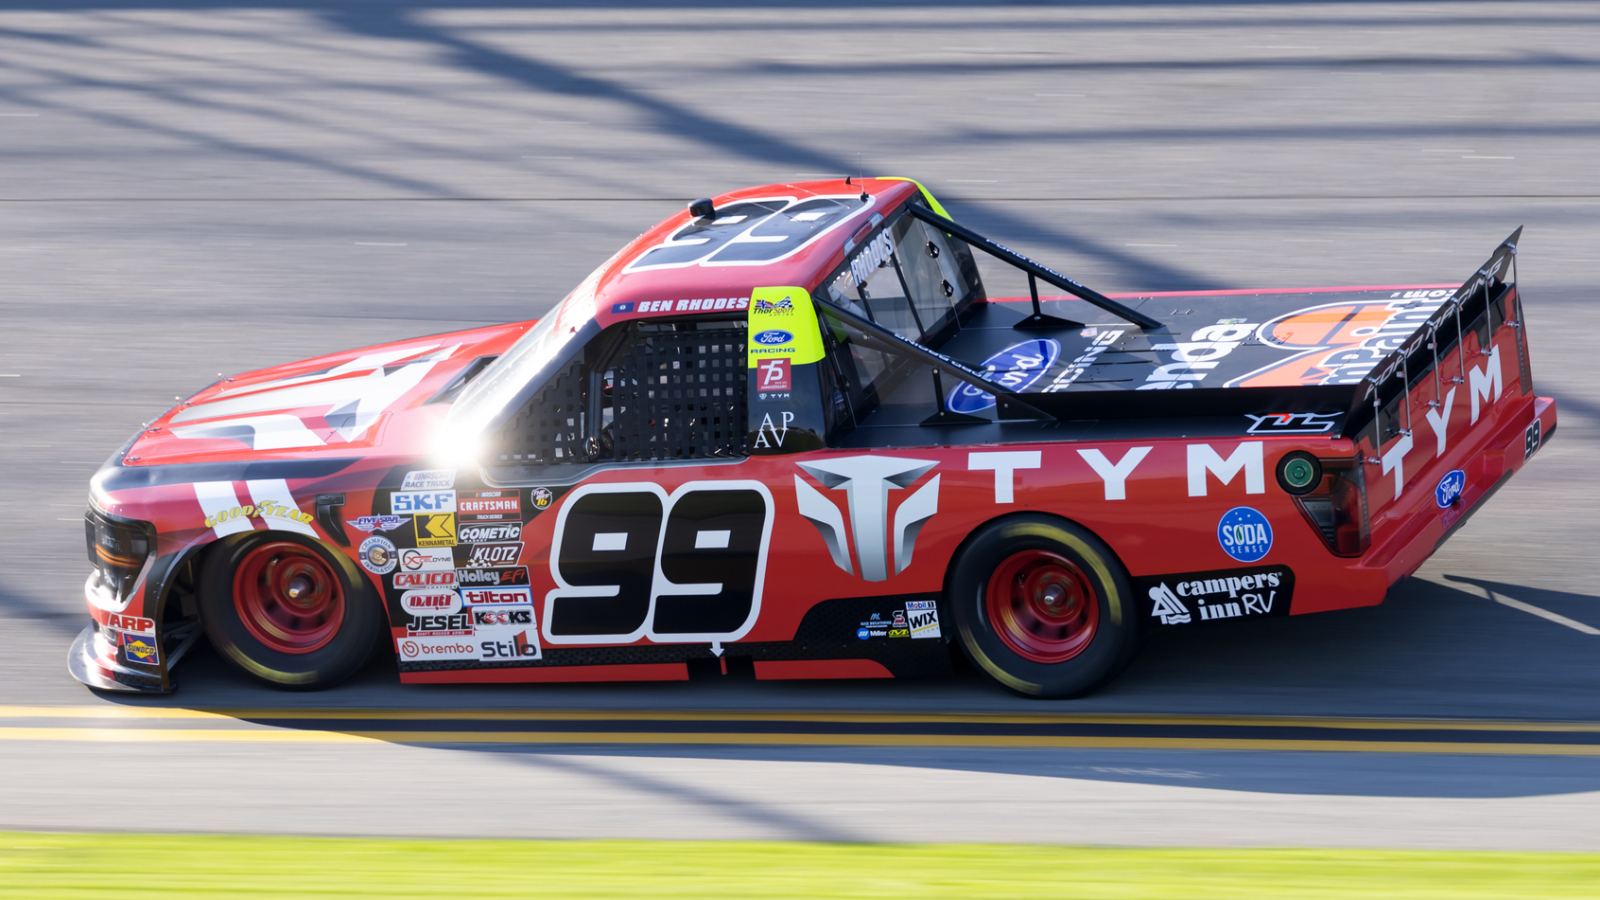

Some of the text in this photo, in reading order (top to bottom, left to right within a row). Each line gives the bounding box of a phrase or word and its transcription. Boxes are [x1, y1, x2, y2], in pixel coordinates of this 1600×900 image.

[621, 194, 876, 274] 99
[850, 228, 893, 286] RHODES
[637, 297, 749, 312] BEN RHODES
[760, 331, 785, 344] Ford
[760, 360, 784, 385] 75
[1381, 344, 1503, 501] TYM
[1523, 418, 1540, 464] 99
[421, 472, 449, 480] NASCAR
[968, 441, 1265, 503] TYM
[1440, 475, 1461, 504] Ford
[394, 493, 453, 511] SKF
[460, 500, 518, 511] CRAFTSMAN
[537, 498, 548, 506] 16
[204, 500, 314, 528] GOODYEAR
[460, 526, 520, 540] COMETIC
[1222, 523, 1268, 546] SODA
[361, 538, 392, 550] CHAMPION
[1230, 545, 1263, 554] SENSE
[473, 546, 518, 561] KLOTZ
[542, 480, 775, 644] 99
[395, 573, 454, 586] CALICO
[460, 569, 525, 585] Holley EFI
[1176, 572, 1280, 598] campers
[410, 594, 454, 609] DART
[466, 591, 527, 603] tilton
[1198, 590, 1276, 620] inn RV
[110, 614, 153, 631] ARP
[408, 615, 469, 631] JESEL
[475, 610, 531, 624] KOOKS
[910, 611, 937, 629] WIX
[126, 644, 155, 655] SUNOCO
[421, 643, 474, 654] brembo
[481, 634, 536, 657] Stilo
